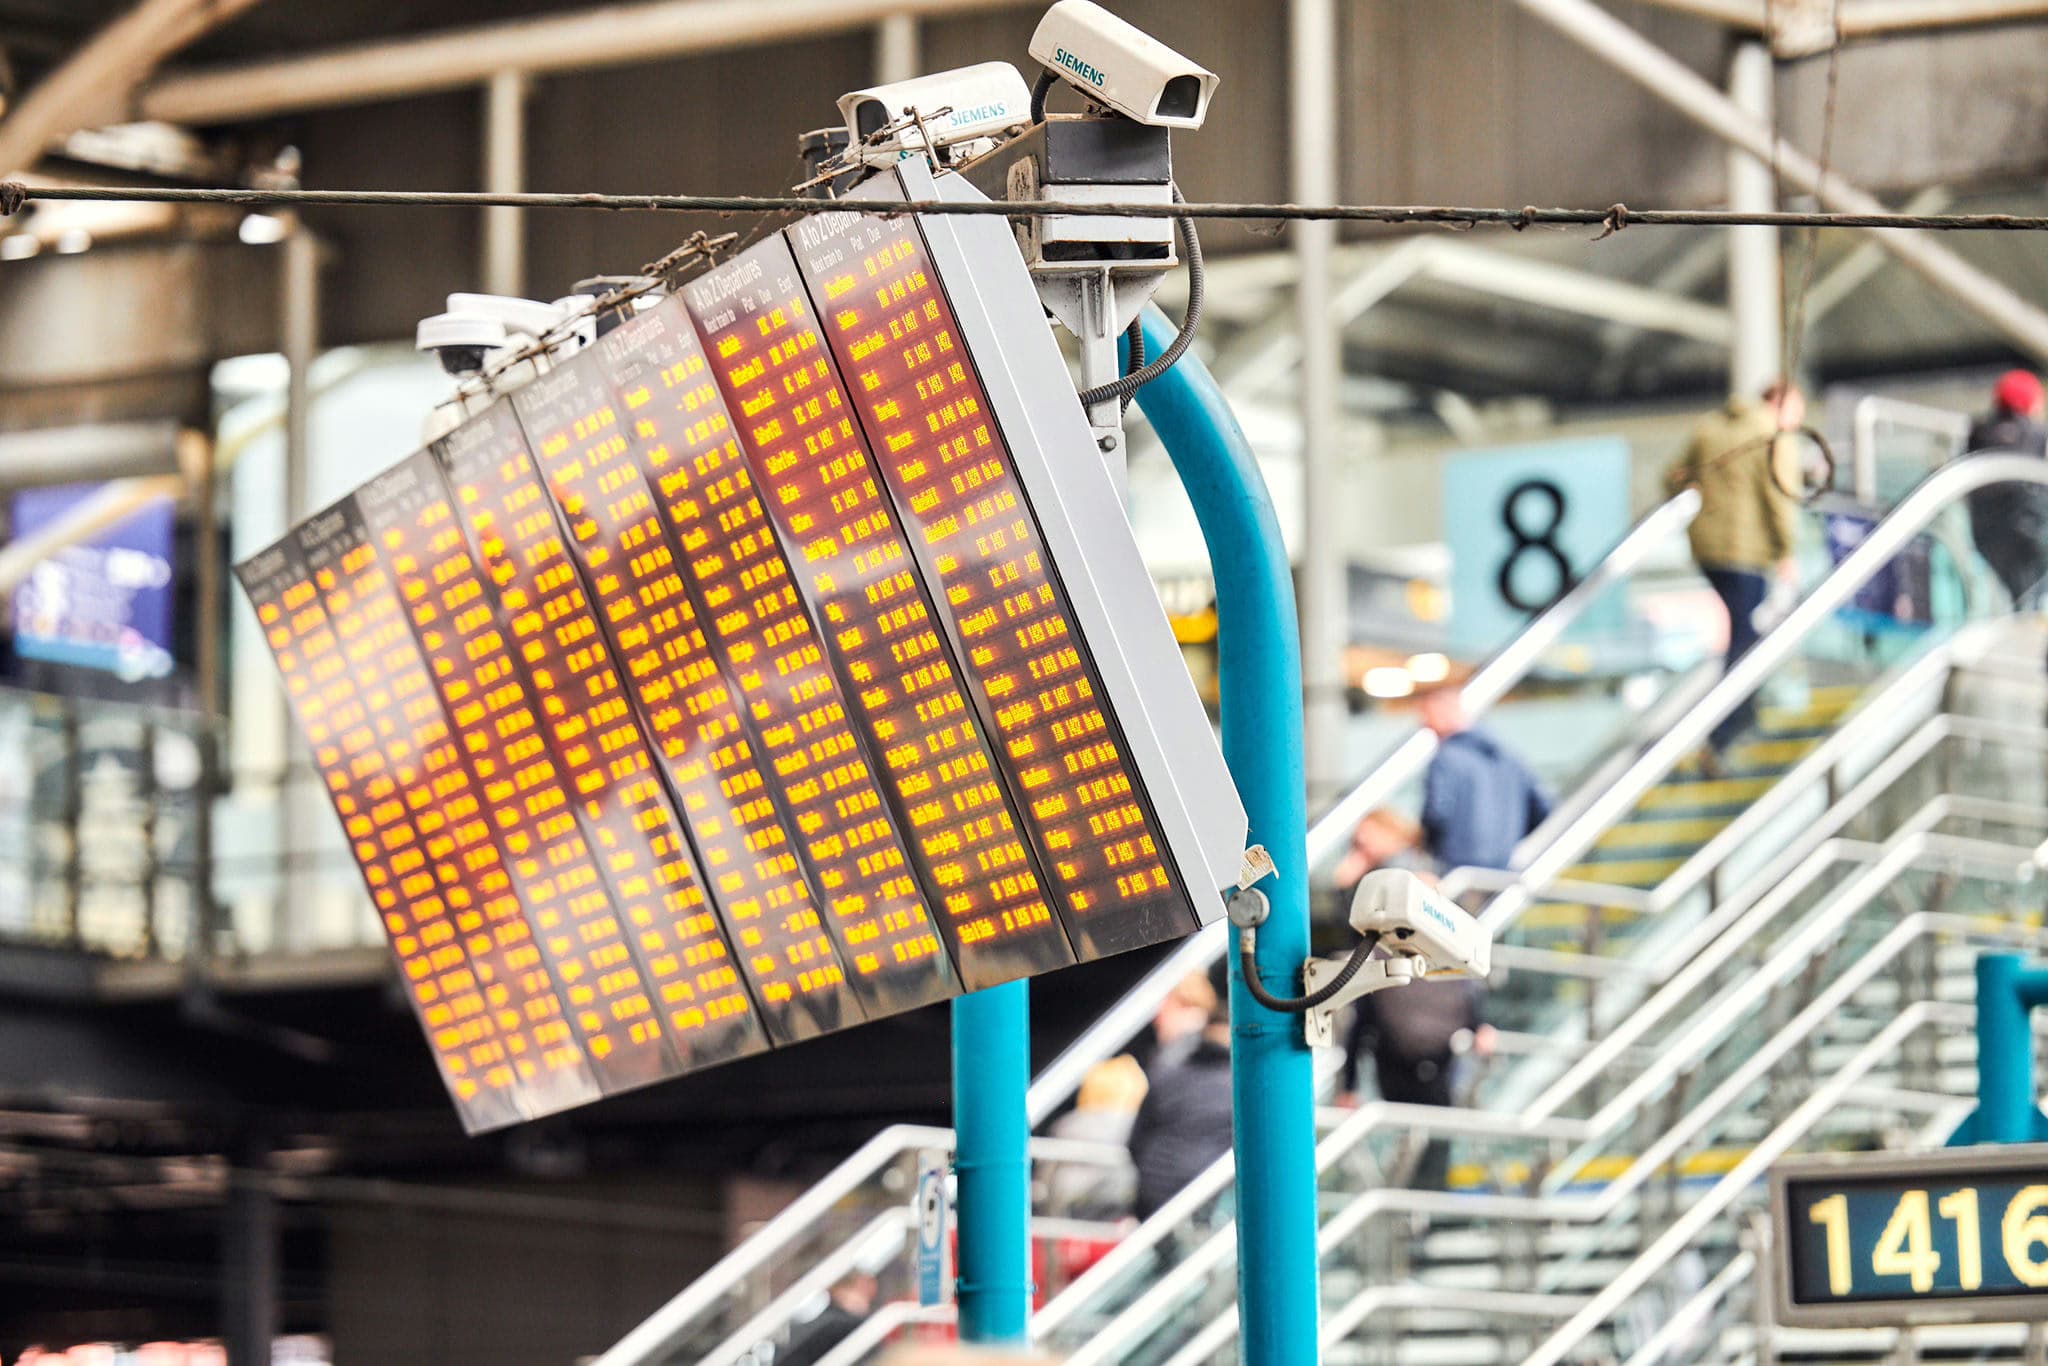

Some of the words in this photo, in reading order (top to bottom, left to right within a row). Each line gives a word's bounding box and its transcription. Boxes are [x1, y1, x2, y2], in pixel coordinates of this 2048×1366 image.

[1055, 48, 1105, 86] SIEMENS
[951, 103, 1006, 127] SIEMENS
[799, 225, 812, 252] A
[806, 224, 820, 247] to
[815, 215, 829, 241] Z
[866, 226, 882, 244] Due
[714, 259, 763, 299] Departures
[1496, 478, 1582, 615] 8
[1422, 899, 1457, 933] SIEMENS
[1809, 1184, 2048, 1296] 1416
